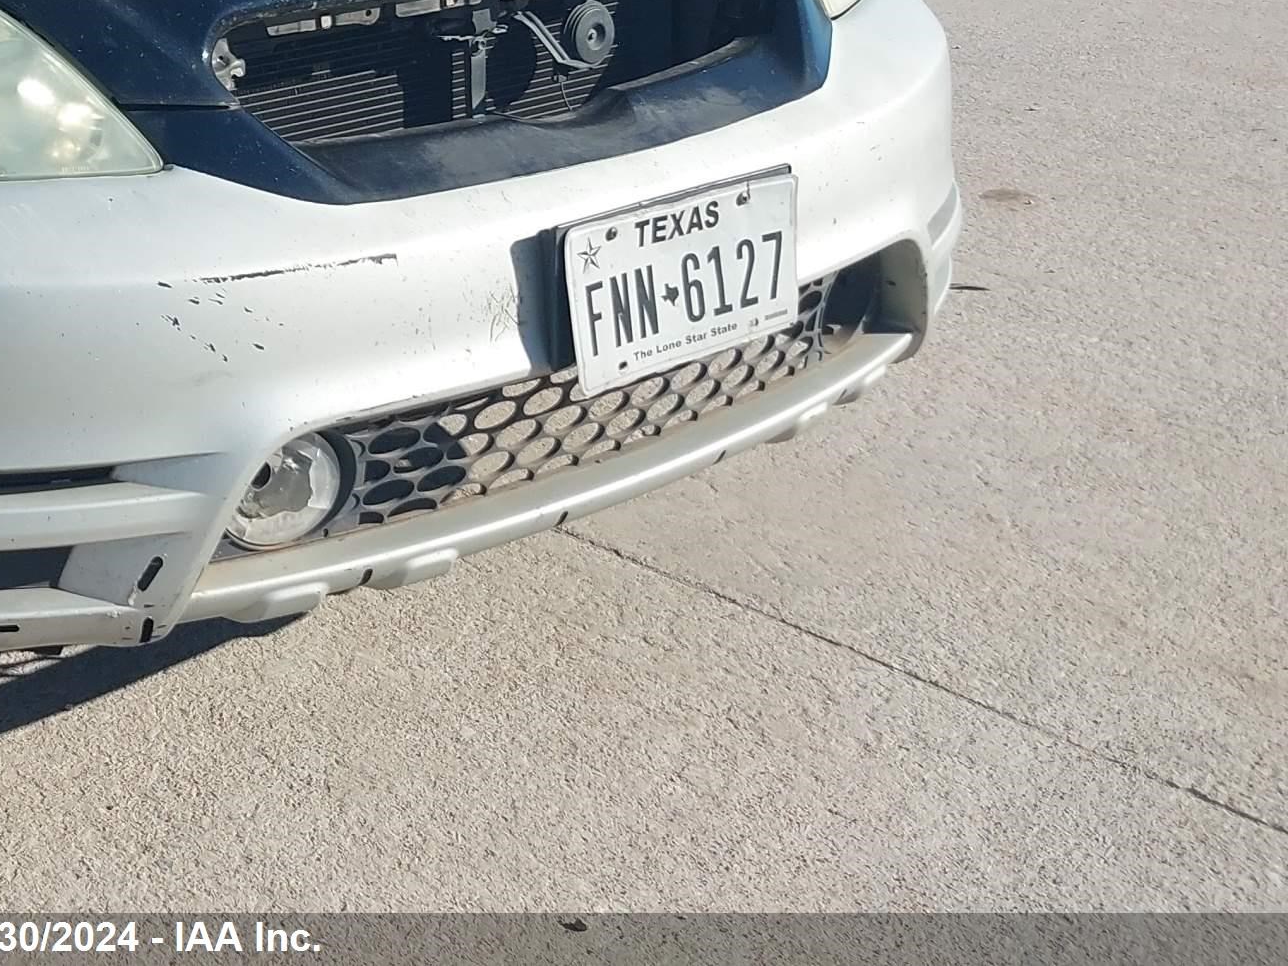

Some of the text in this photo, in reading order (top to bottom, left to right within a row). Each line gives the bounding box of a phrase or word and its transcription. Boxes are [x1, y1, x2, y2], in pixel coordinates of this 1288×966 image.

[634, 200, 719, 248] TEXAS
[585, 230, 783, 357] FNN 6127
[633, 322, 738, 361] The Lone Star State
